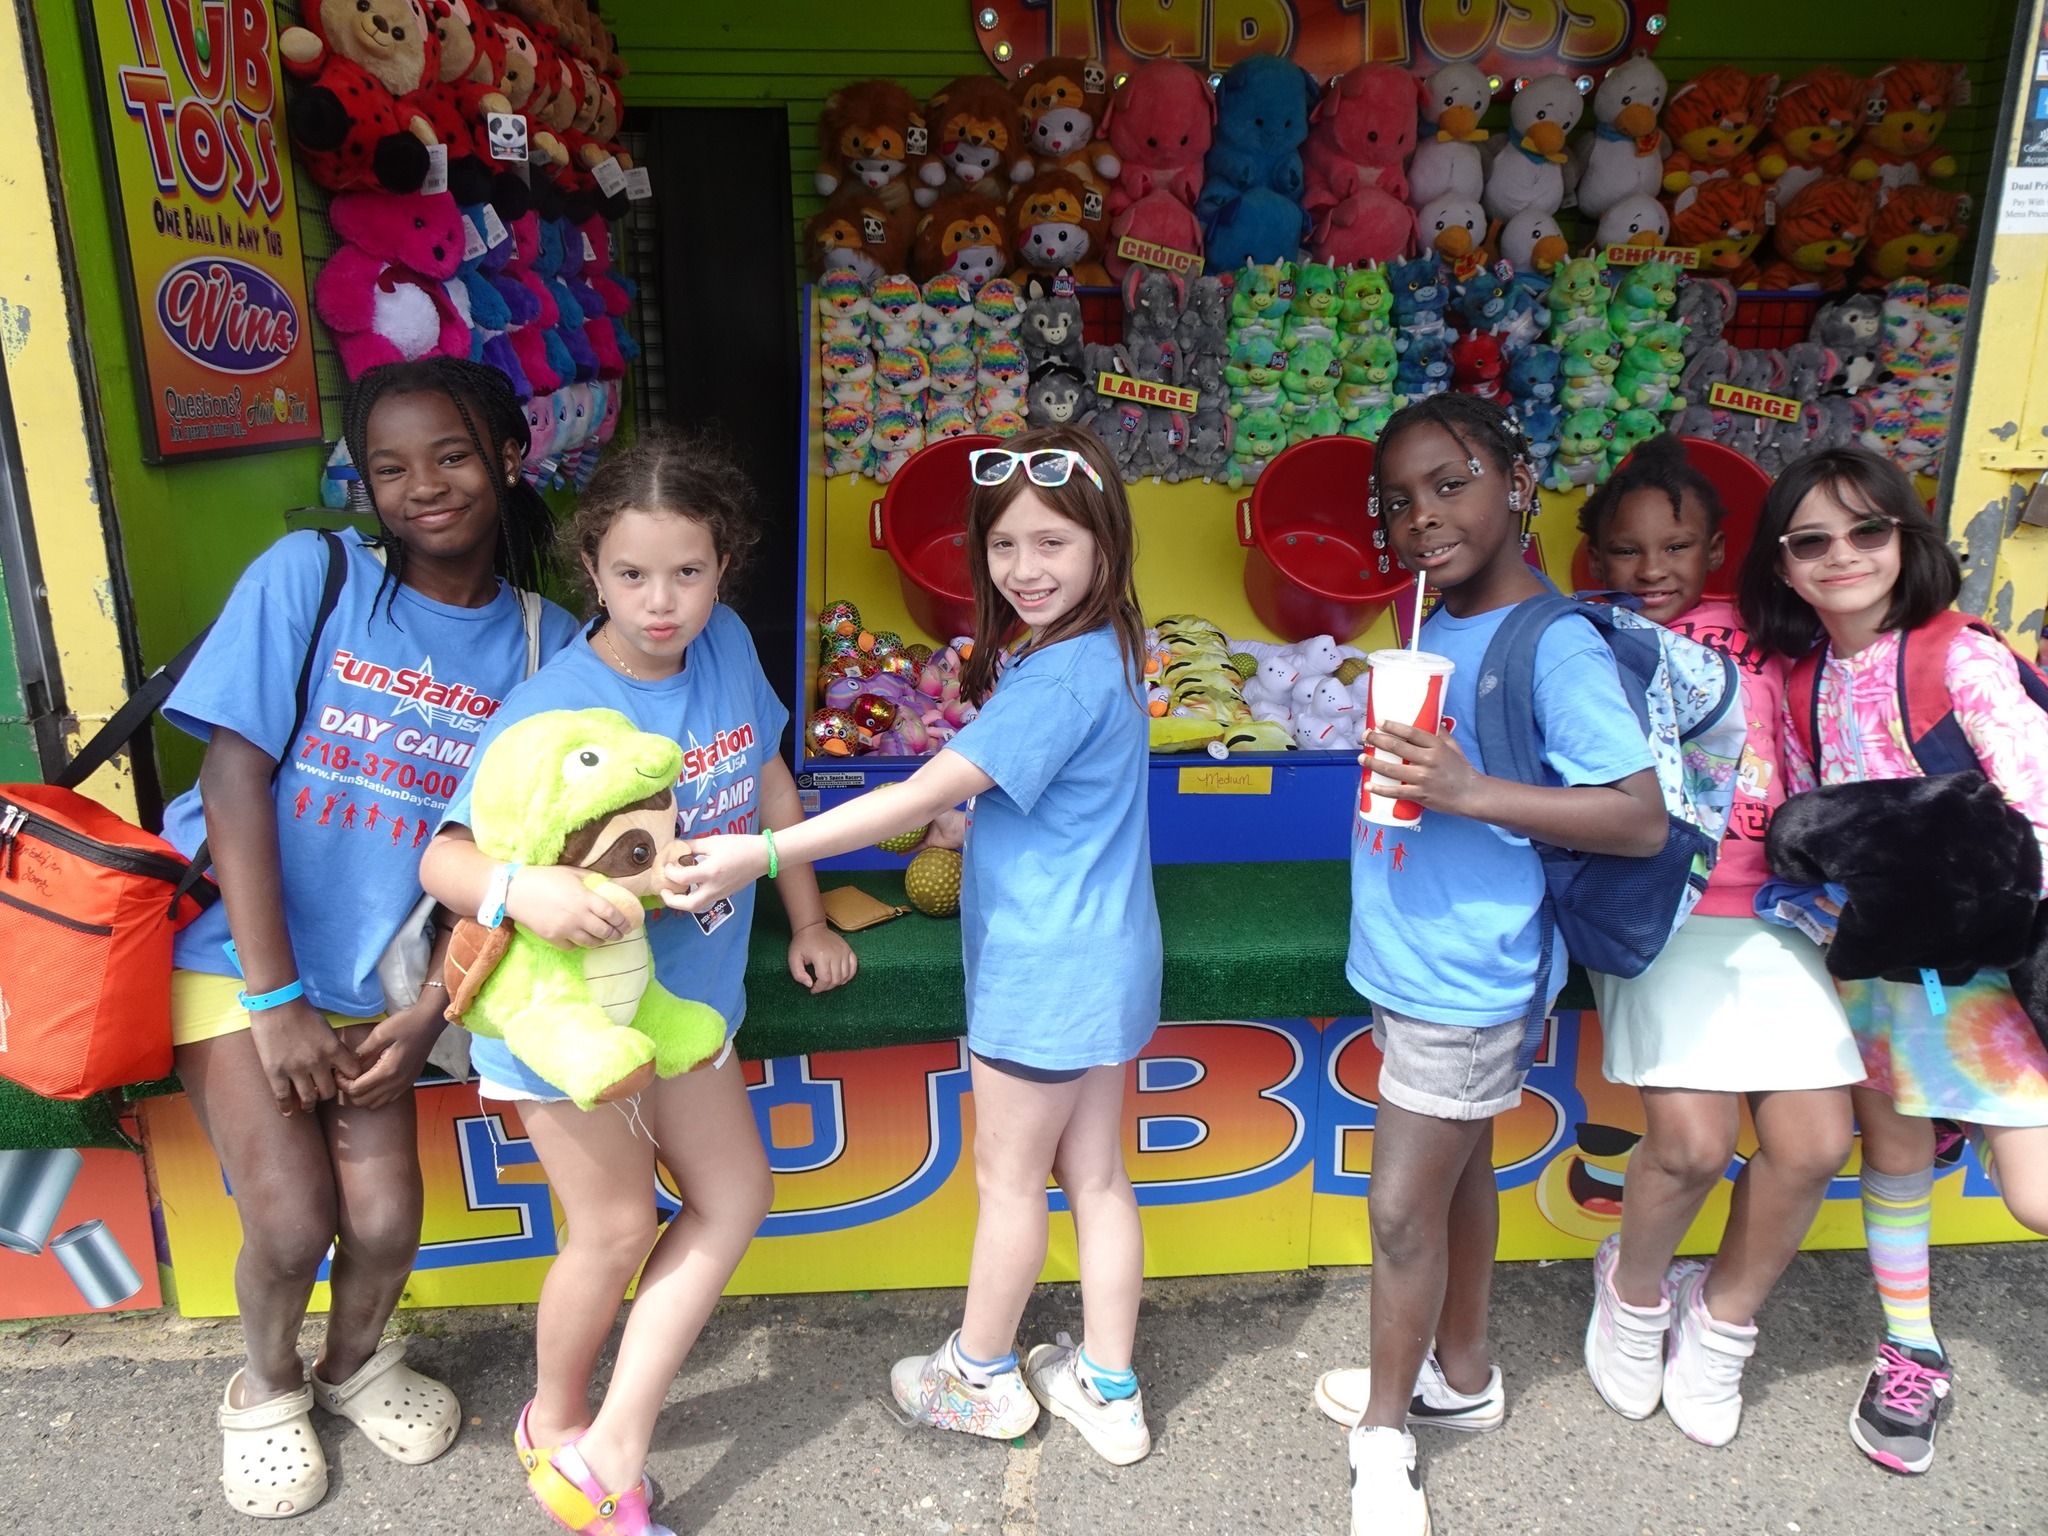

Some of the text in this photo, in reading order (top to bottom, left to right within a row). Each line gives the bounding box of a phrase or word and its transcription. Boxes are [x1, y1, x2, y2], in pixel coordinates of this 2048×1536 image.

[119, 65, 284, 218] TOSS
[2011, 182, 2032, 191] Dual
[1608, 247, 1697, 266] CHOICE
[166, 264, 295, 354] Wins
[165, 385, 242, 424] Questions?
[1103, 377, 1194, 408] LARGE
[1714, 387, 1797, 419] LARGE
[319, 705, 397, 744] DAY
[301, 735, 464, 799] 718-370-00
[725, 754, 747, 773] USA
[1198, 772, 1254, 788] Medium
